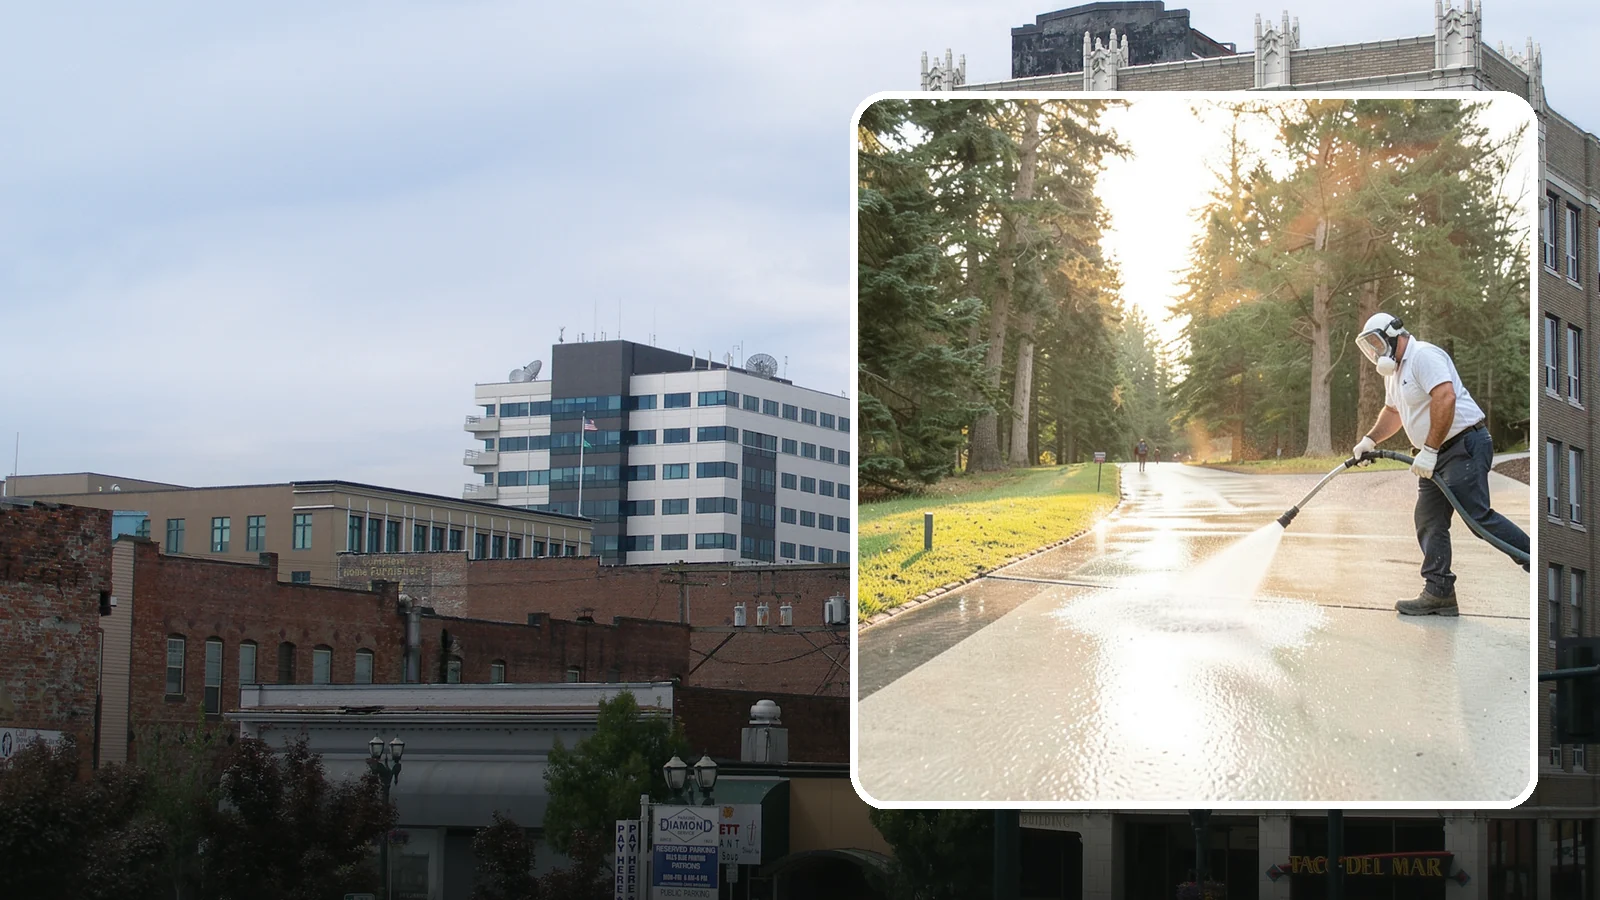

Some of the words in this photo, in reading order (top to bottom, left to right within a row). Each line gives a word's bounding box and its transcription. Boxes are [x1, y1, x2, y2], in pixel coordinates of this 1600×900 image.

[370, 566, 428, 576] Furnishers
[660, 818, 713, 833] DIAMOND
[1022, 815, 1070, 827] BUILDING
[617, 825, 625, 852] PAY
[629, 824, 637, 852] PAY
[656, 845, 688, 853] RESERVED
[721, 852, 739, 861] Soup
[671, 862, 701, 870] PATRONS
[1346, 857, 1384, 875] DEL
[1392, 857, 1442, 876] MAR
[616, 856, 625, 894] HERE
[628, 856, 636, 893] HERE
[661, 888, 682, 897] PUBLIC
[684, 890, 710, 898] PARKING
